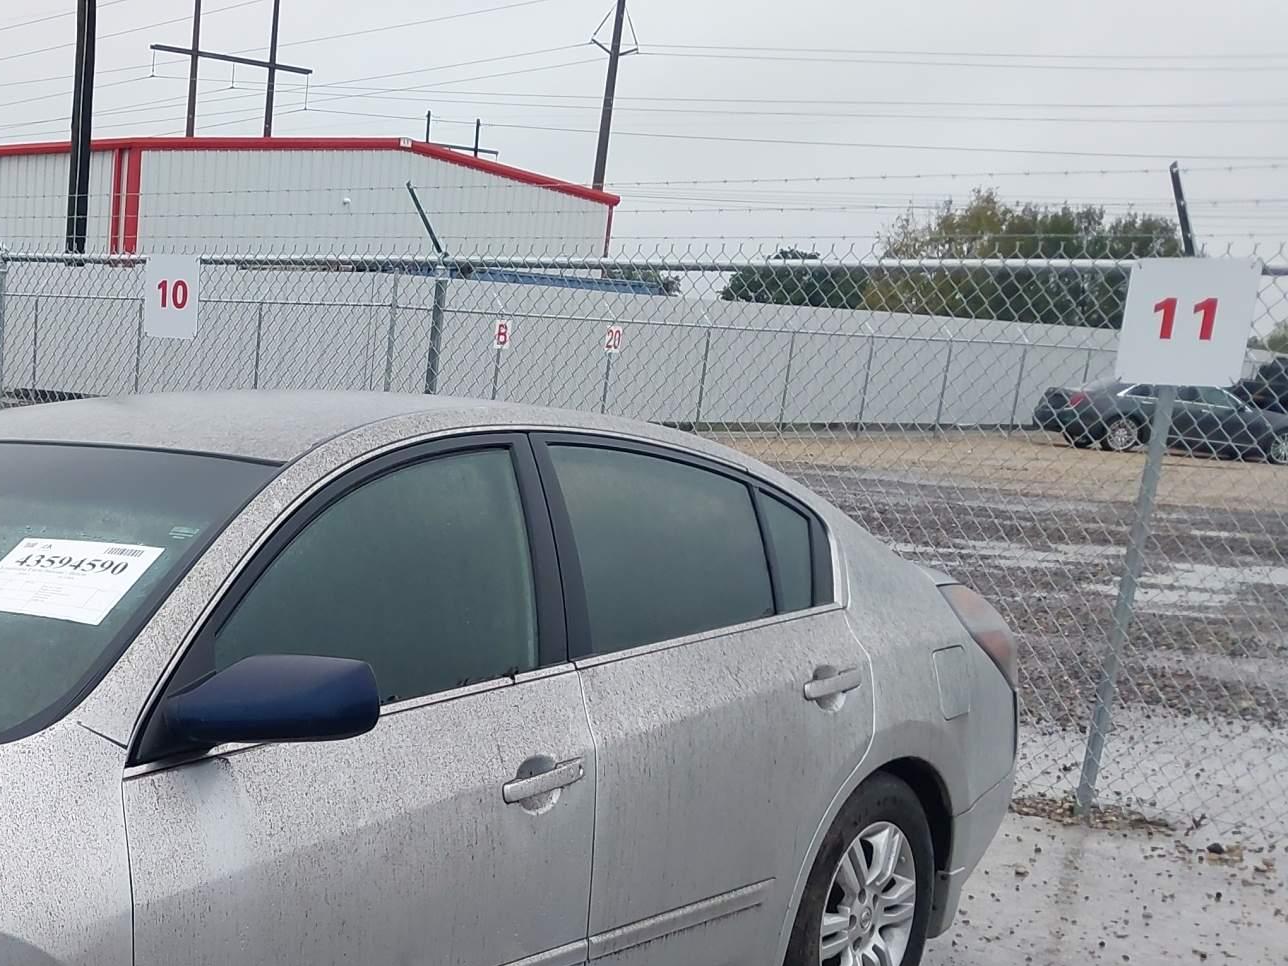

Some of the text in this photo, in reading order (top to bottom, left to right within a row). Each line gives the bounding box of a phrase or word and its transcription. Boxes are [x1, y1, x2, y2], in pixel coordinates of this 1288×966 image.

[157, 280, 188, 309] 10
[1153, 297, 1218, 340] 11
[605, 328, 622, 349] 20
[15, 553, 129, 576] 43594590
